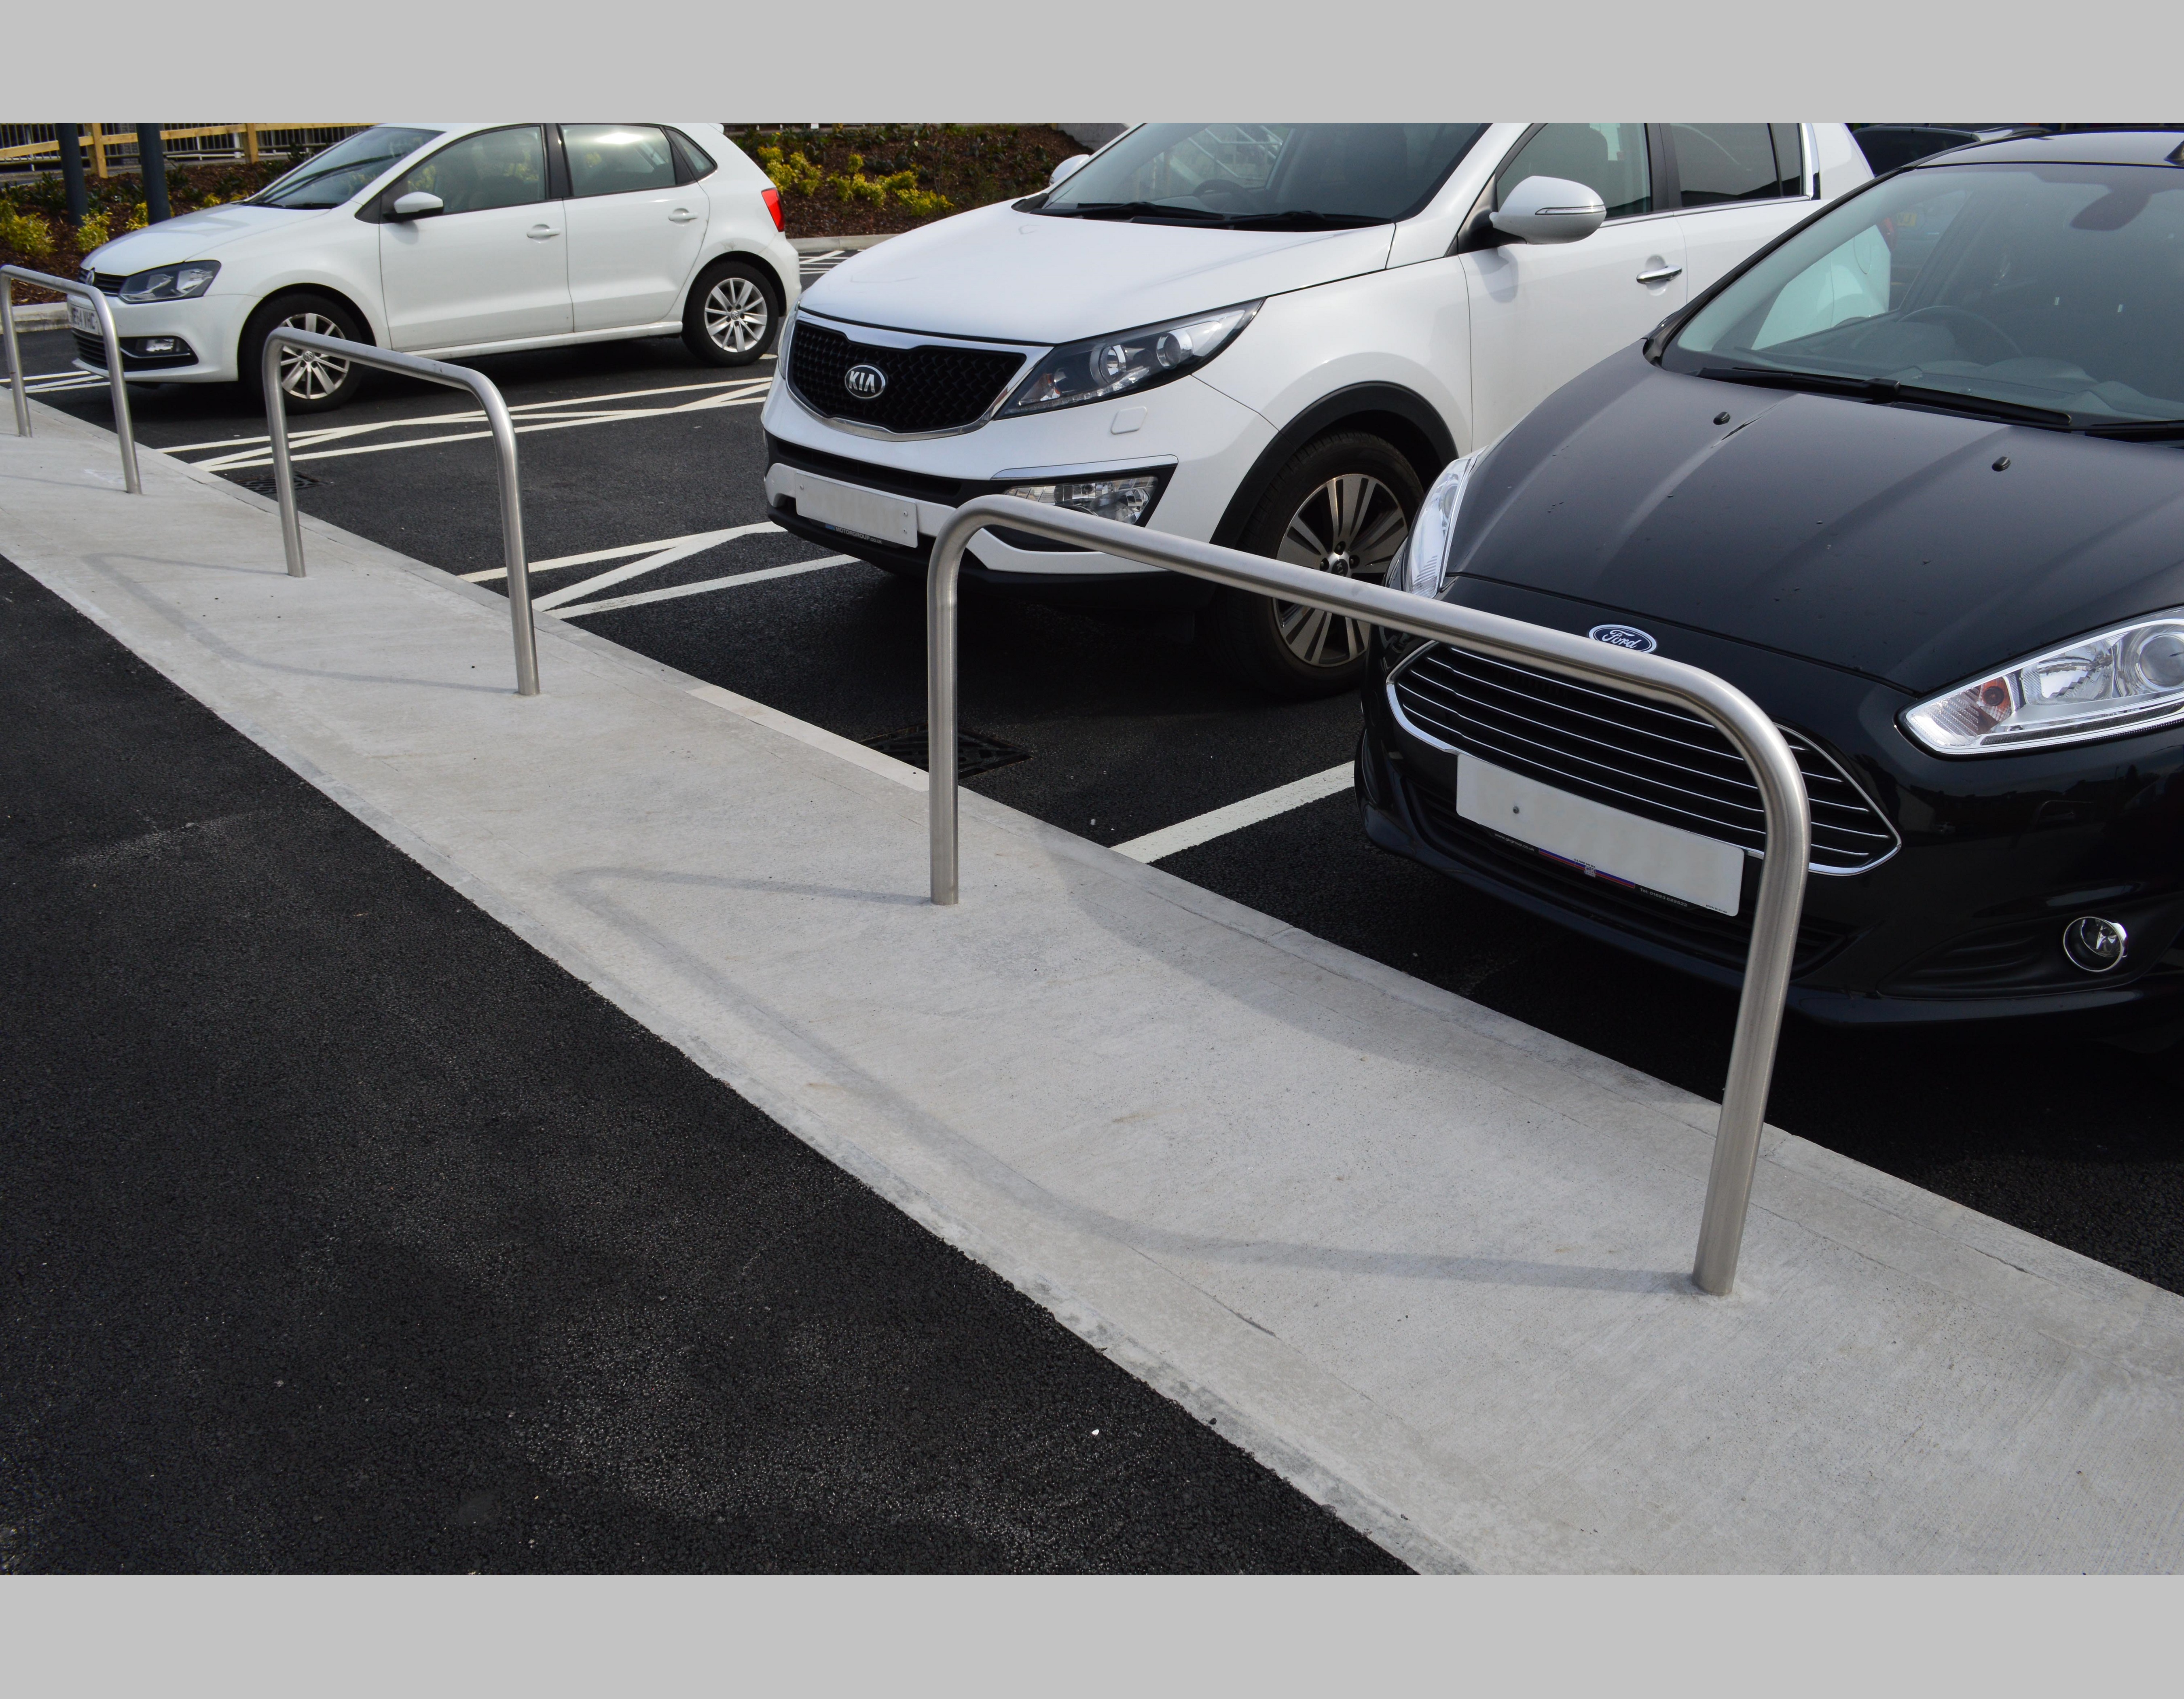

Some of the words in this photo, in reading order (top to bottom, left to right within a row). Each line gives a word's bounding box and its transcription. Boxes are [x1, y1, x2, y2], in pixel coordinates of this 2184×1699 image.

[849, 371, 876, 393] KIA
[1602, 629, 1642, 648] Ford
[1494, 833, 1534, 852] www.gkgroup.co.uk
[1649, 891, 1666, 900] 01623
